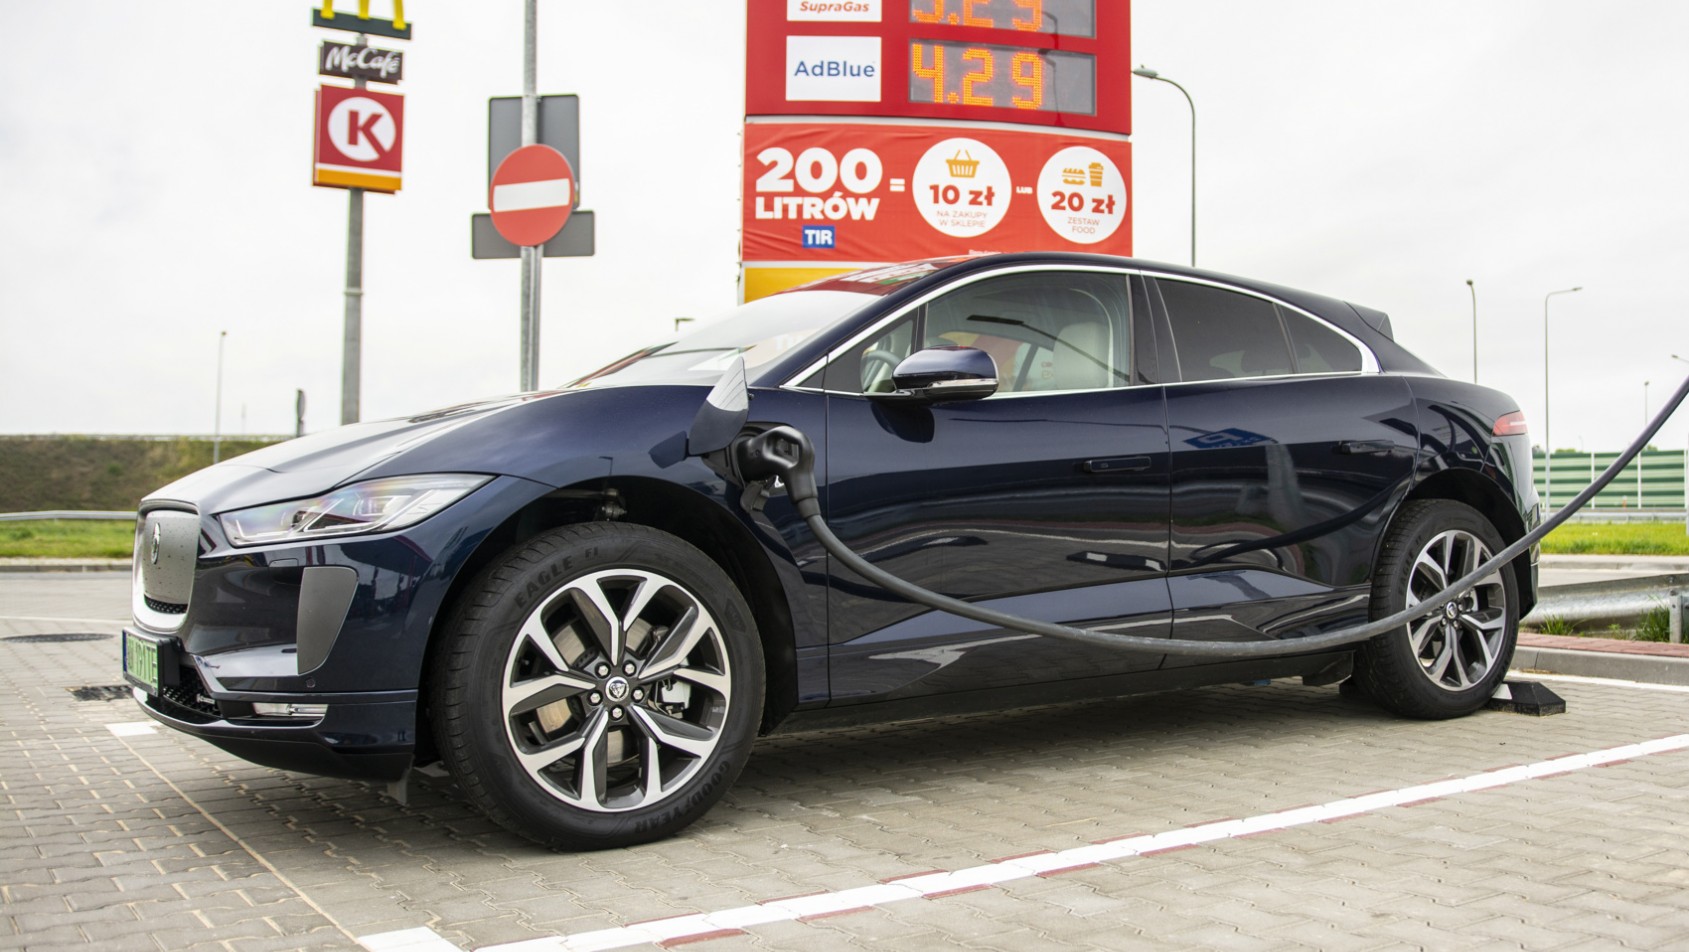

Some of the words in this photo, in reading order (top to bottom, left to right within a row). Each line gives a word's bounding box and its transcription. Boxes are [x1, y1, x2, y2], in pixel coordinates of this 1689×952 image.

[799, 1, 870, 14] SupraGas
[325, 45, 400, 79] McCafé
[794, 60, 876, 78] AdBlue
[912, 43, 1043, 110] 4.29
[347, 108, 386, 157] K
[755, 147, 883, 194] 200
[929, 184, 961, 205] 10
[968, 186, 996, 207] zł
[1016, 186, 1034, 195] LUB
[755, 191, 880, 221] LITRÓW
[1051, 191, 1085, 212] 20
[1091, 194, 1117, 215] zł
[936, 210, 950, 218] NA
[952, 211, 988, 219] ZAKUPY
[939, 219, 948, 227] W
[951, 219, 986, 228] SKLEPIE
[1067, 216, 1100, 226] ZESTAW
[804, 229, 833, 245] TIR
[1072, 226, 1096, 235] FOOD
[514, 555, 574, 609] EAGLE
